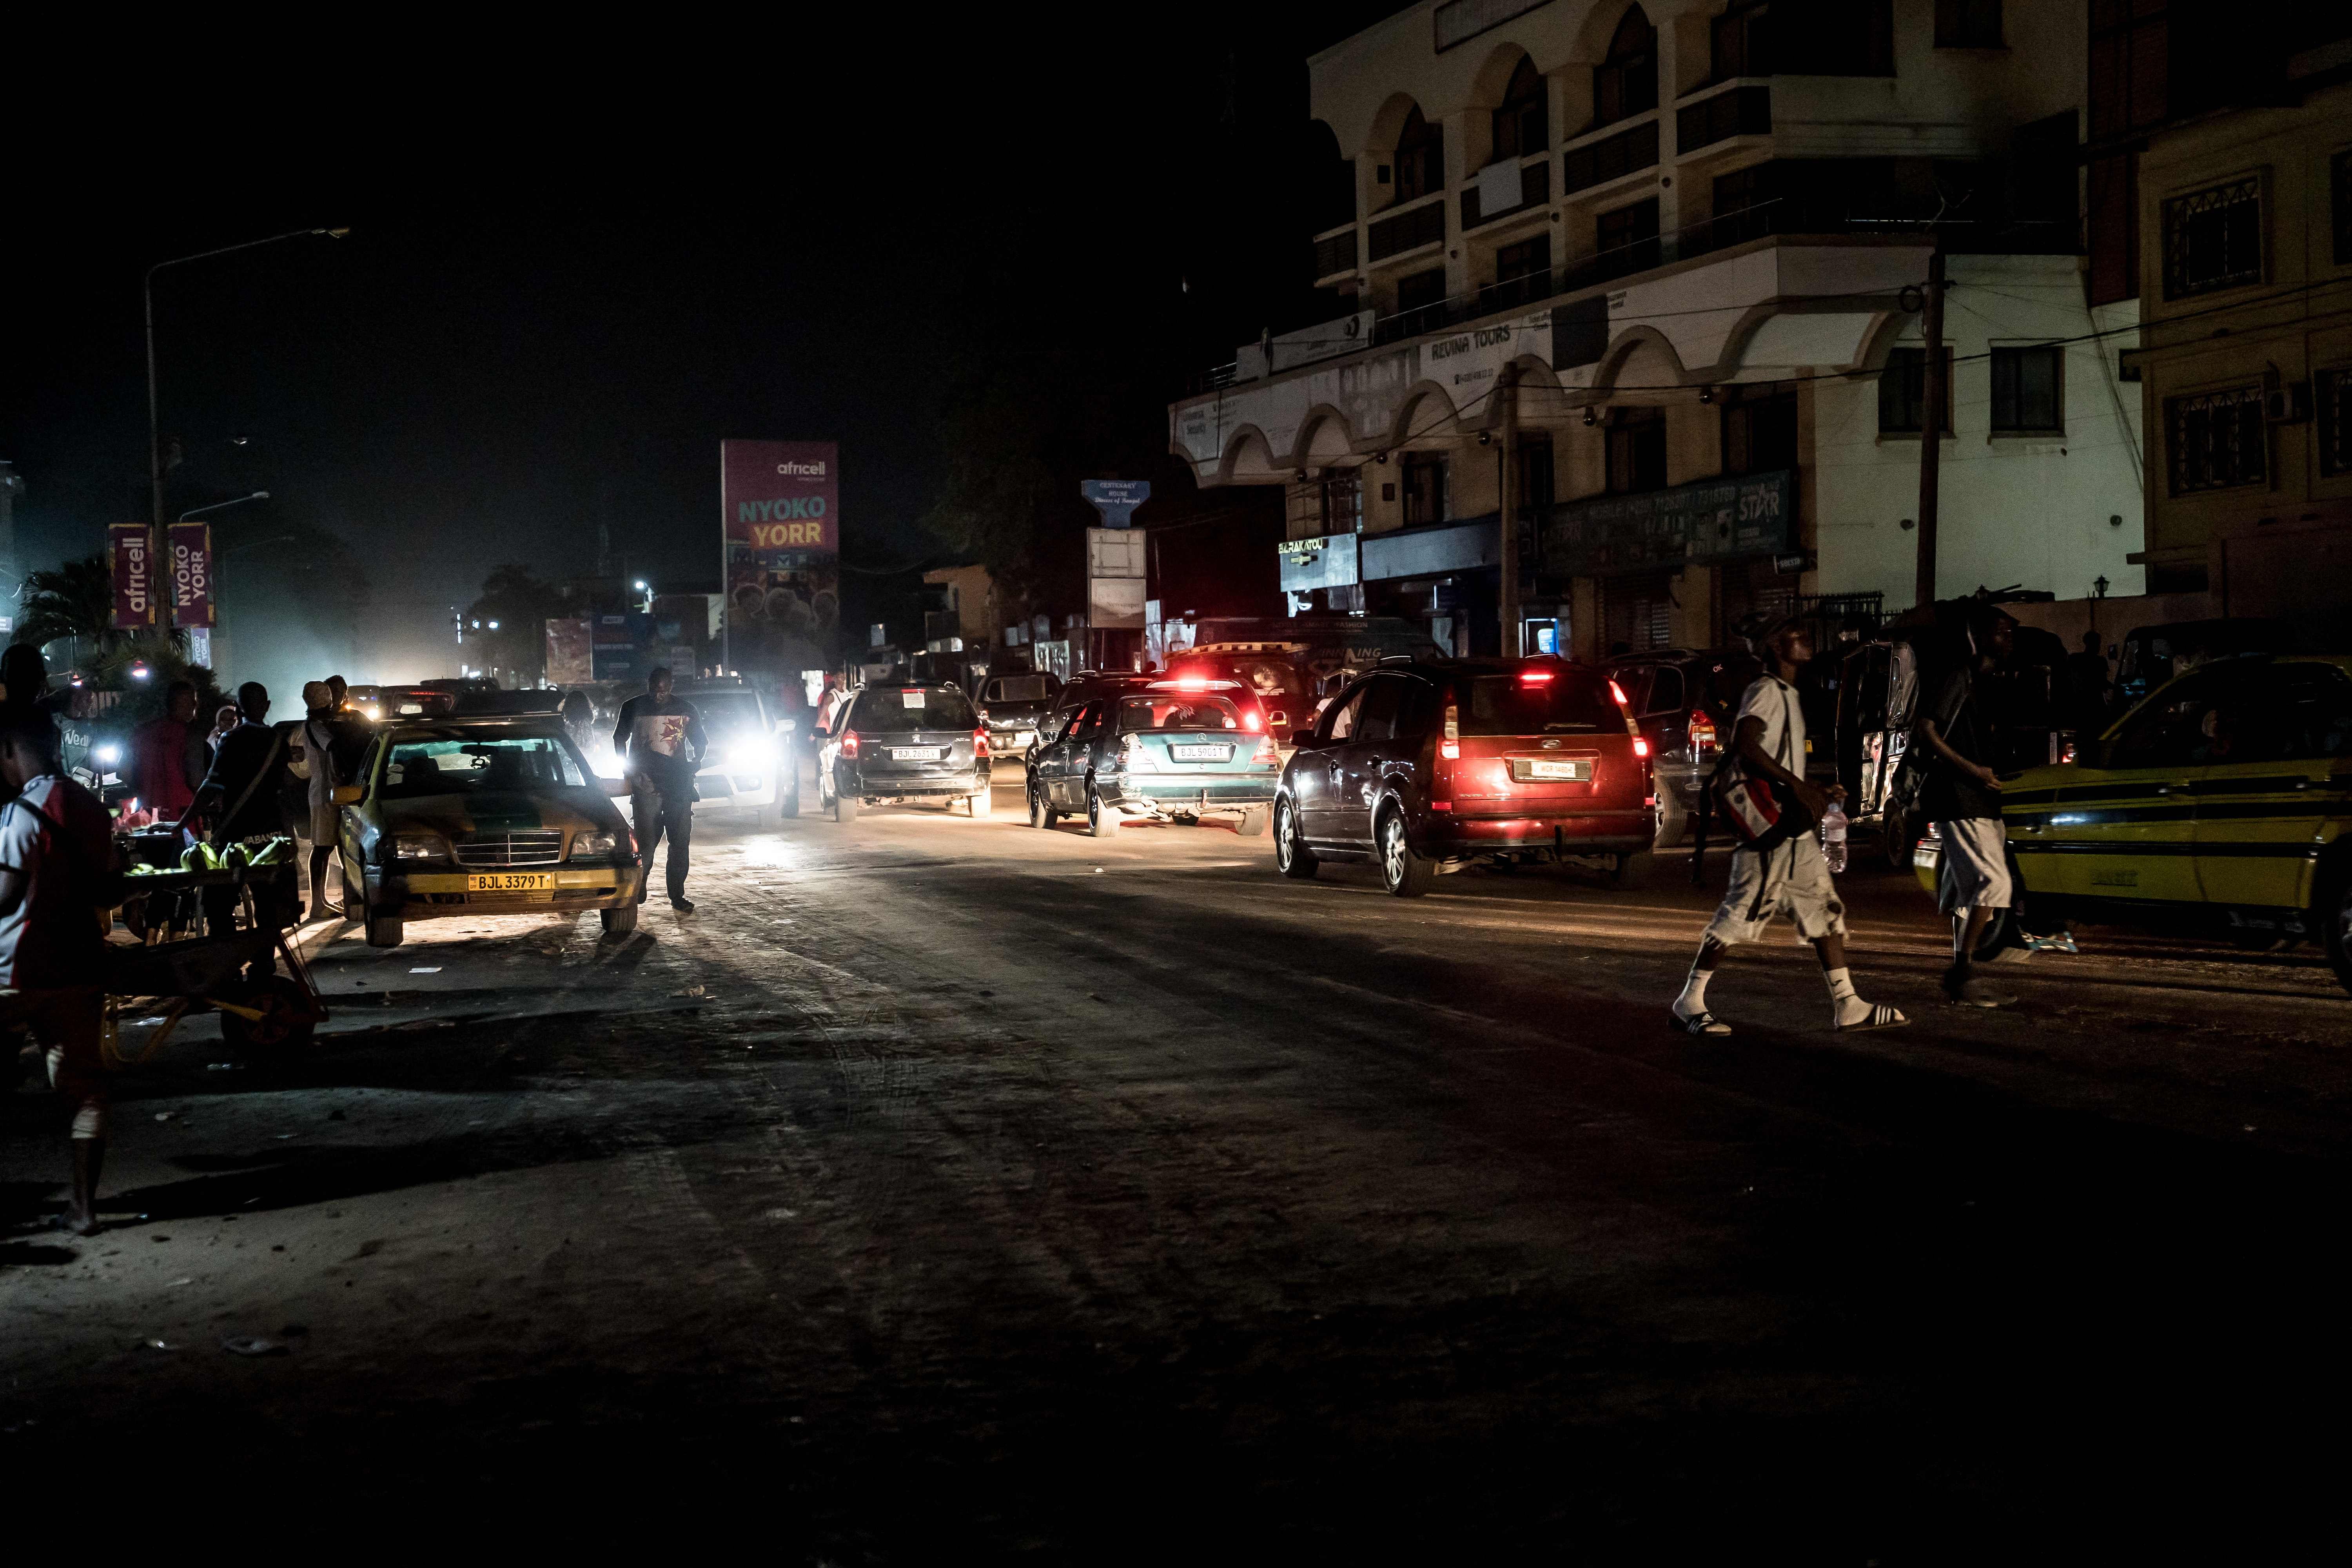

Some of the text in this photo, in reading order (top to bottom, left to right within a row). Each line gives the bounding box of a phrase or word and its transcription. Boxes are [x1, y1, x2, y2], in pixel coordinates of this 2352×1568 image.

[1432, 325, 1510, 360] REVINA TOURS
[777, 461, 825, 475] africell
[739, 496, 826, 523] NYOKO
[1739, 483, 1780, 521] STAR
[753, 523, 821, 546] YORR
[122, 538, 145, 612] africell
[175, 545, 191, 606] NYOKO
[191, 551, 205, 599] YORR
[1713, 664, 1723, 672] OK
[479, 876, 544, 889] BJL 3379 T
